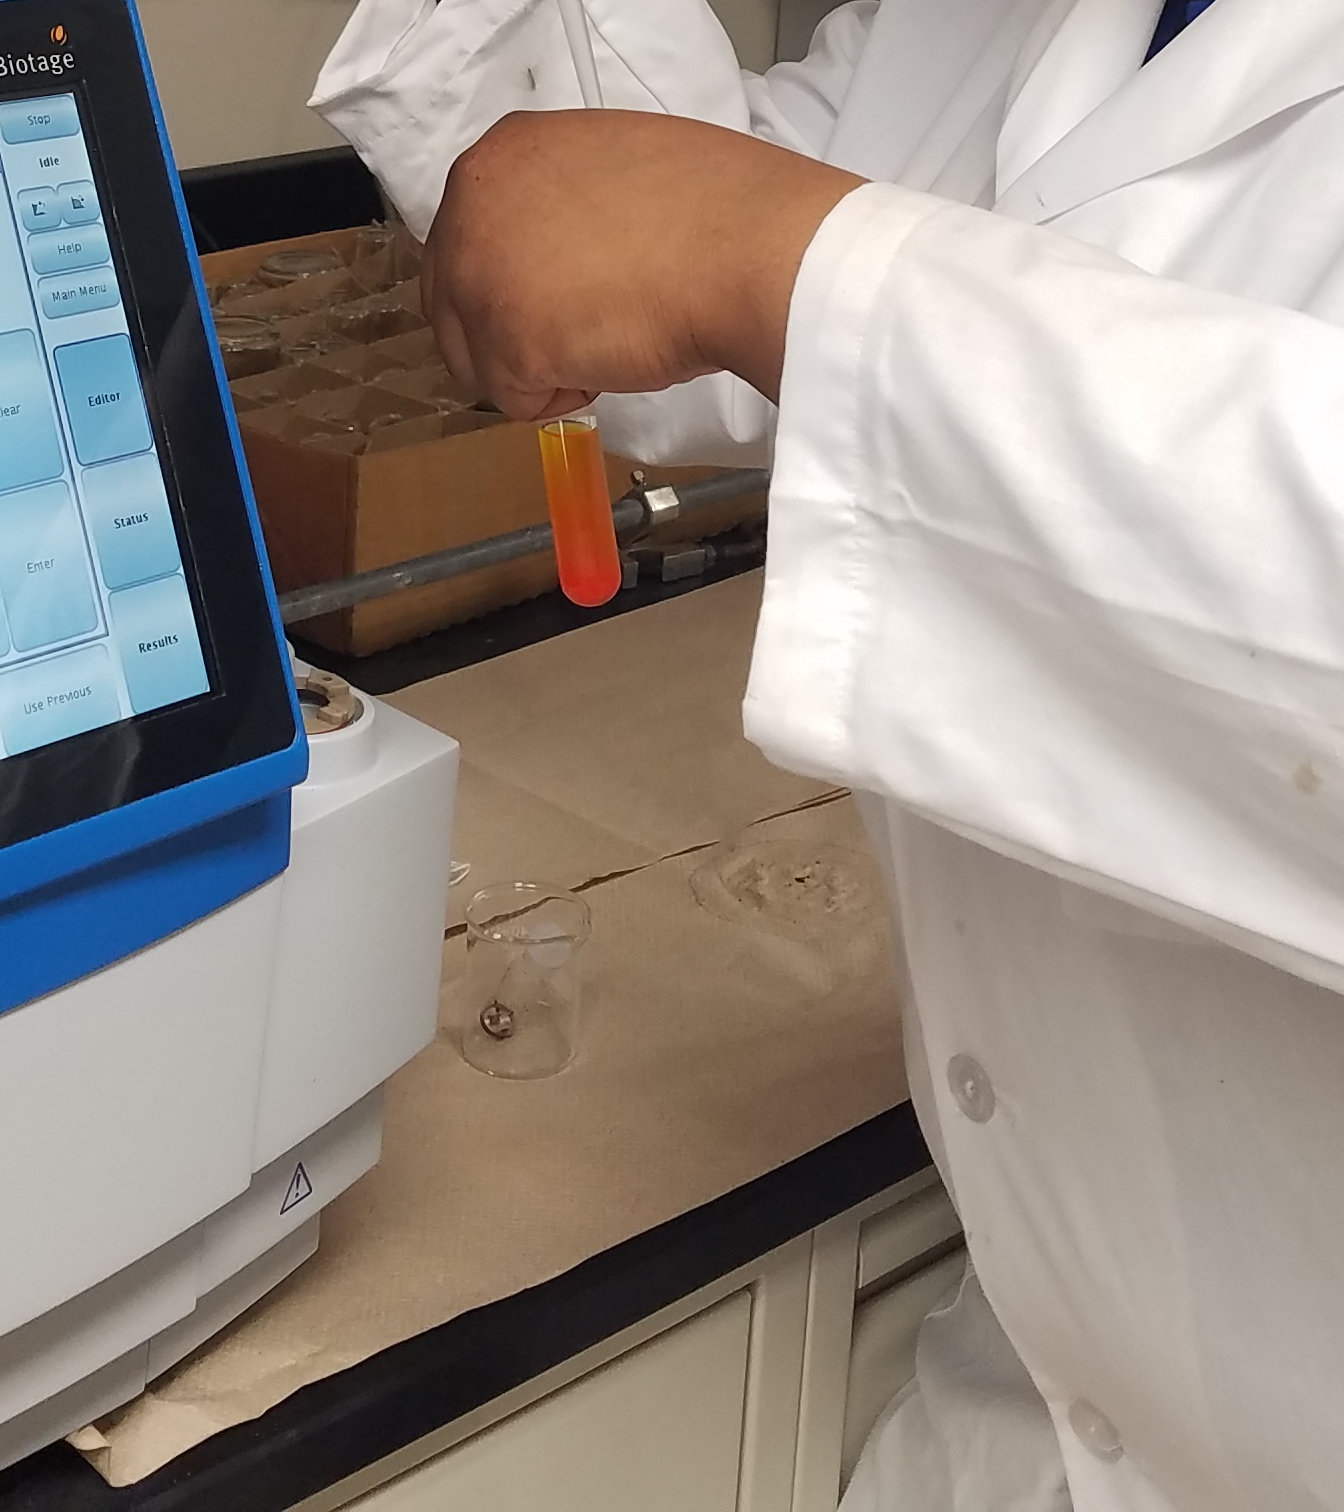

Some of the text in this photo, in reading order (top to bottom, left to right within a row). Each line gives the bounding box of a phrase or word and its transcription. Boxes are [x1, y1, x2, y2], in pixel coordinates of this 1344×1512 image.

[27, 112, 51, 127] Stop
[38, 154, 60, 169] Idle
[58, 243, 82, 254] Help
[52, 285, 107, 302] Main Menu
[88, 391, 120, 408] Editor
[114, 510, 149, 530] Status
[27, 556, 55, 575] Enter
[139, 632, 178, 654] Results
[24, 685, 92, 715] Use Previous
